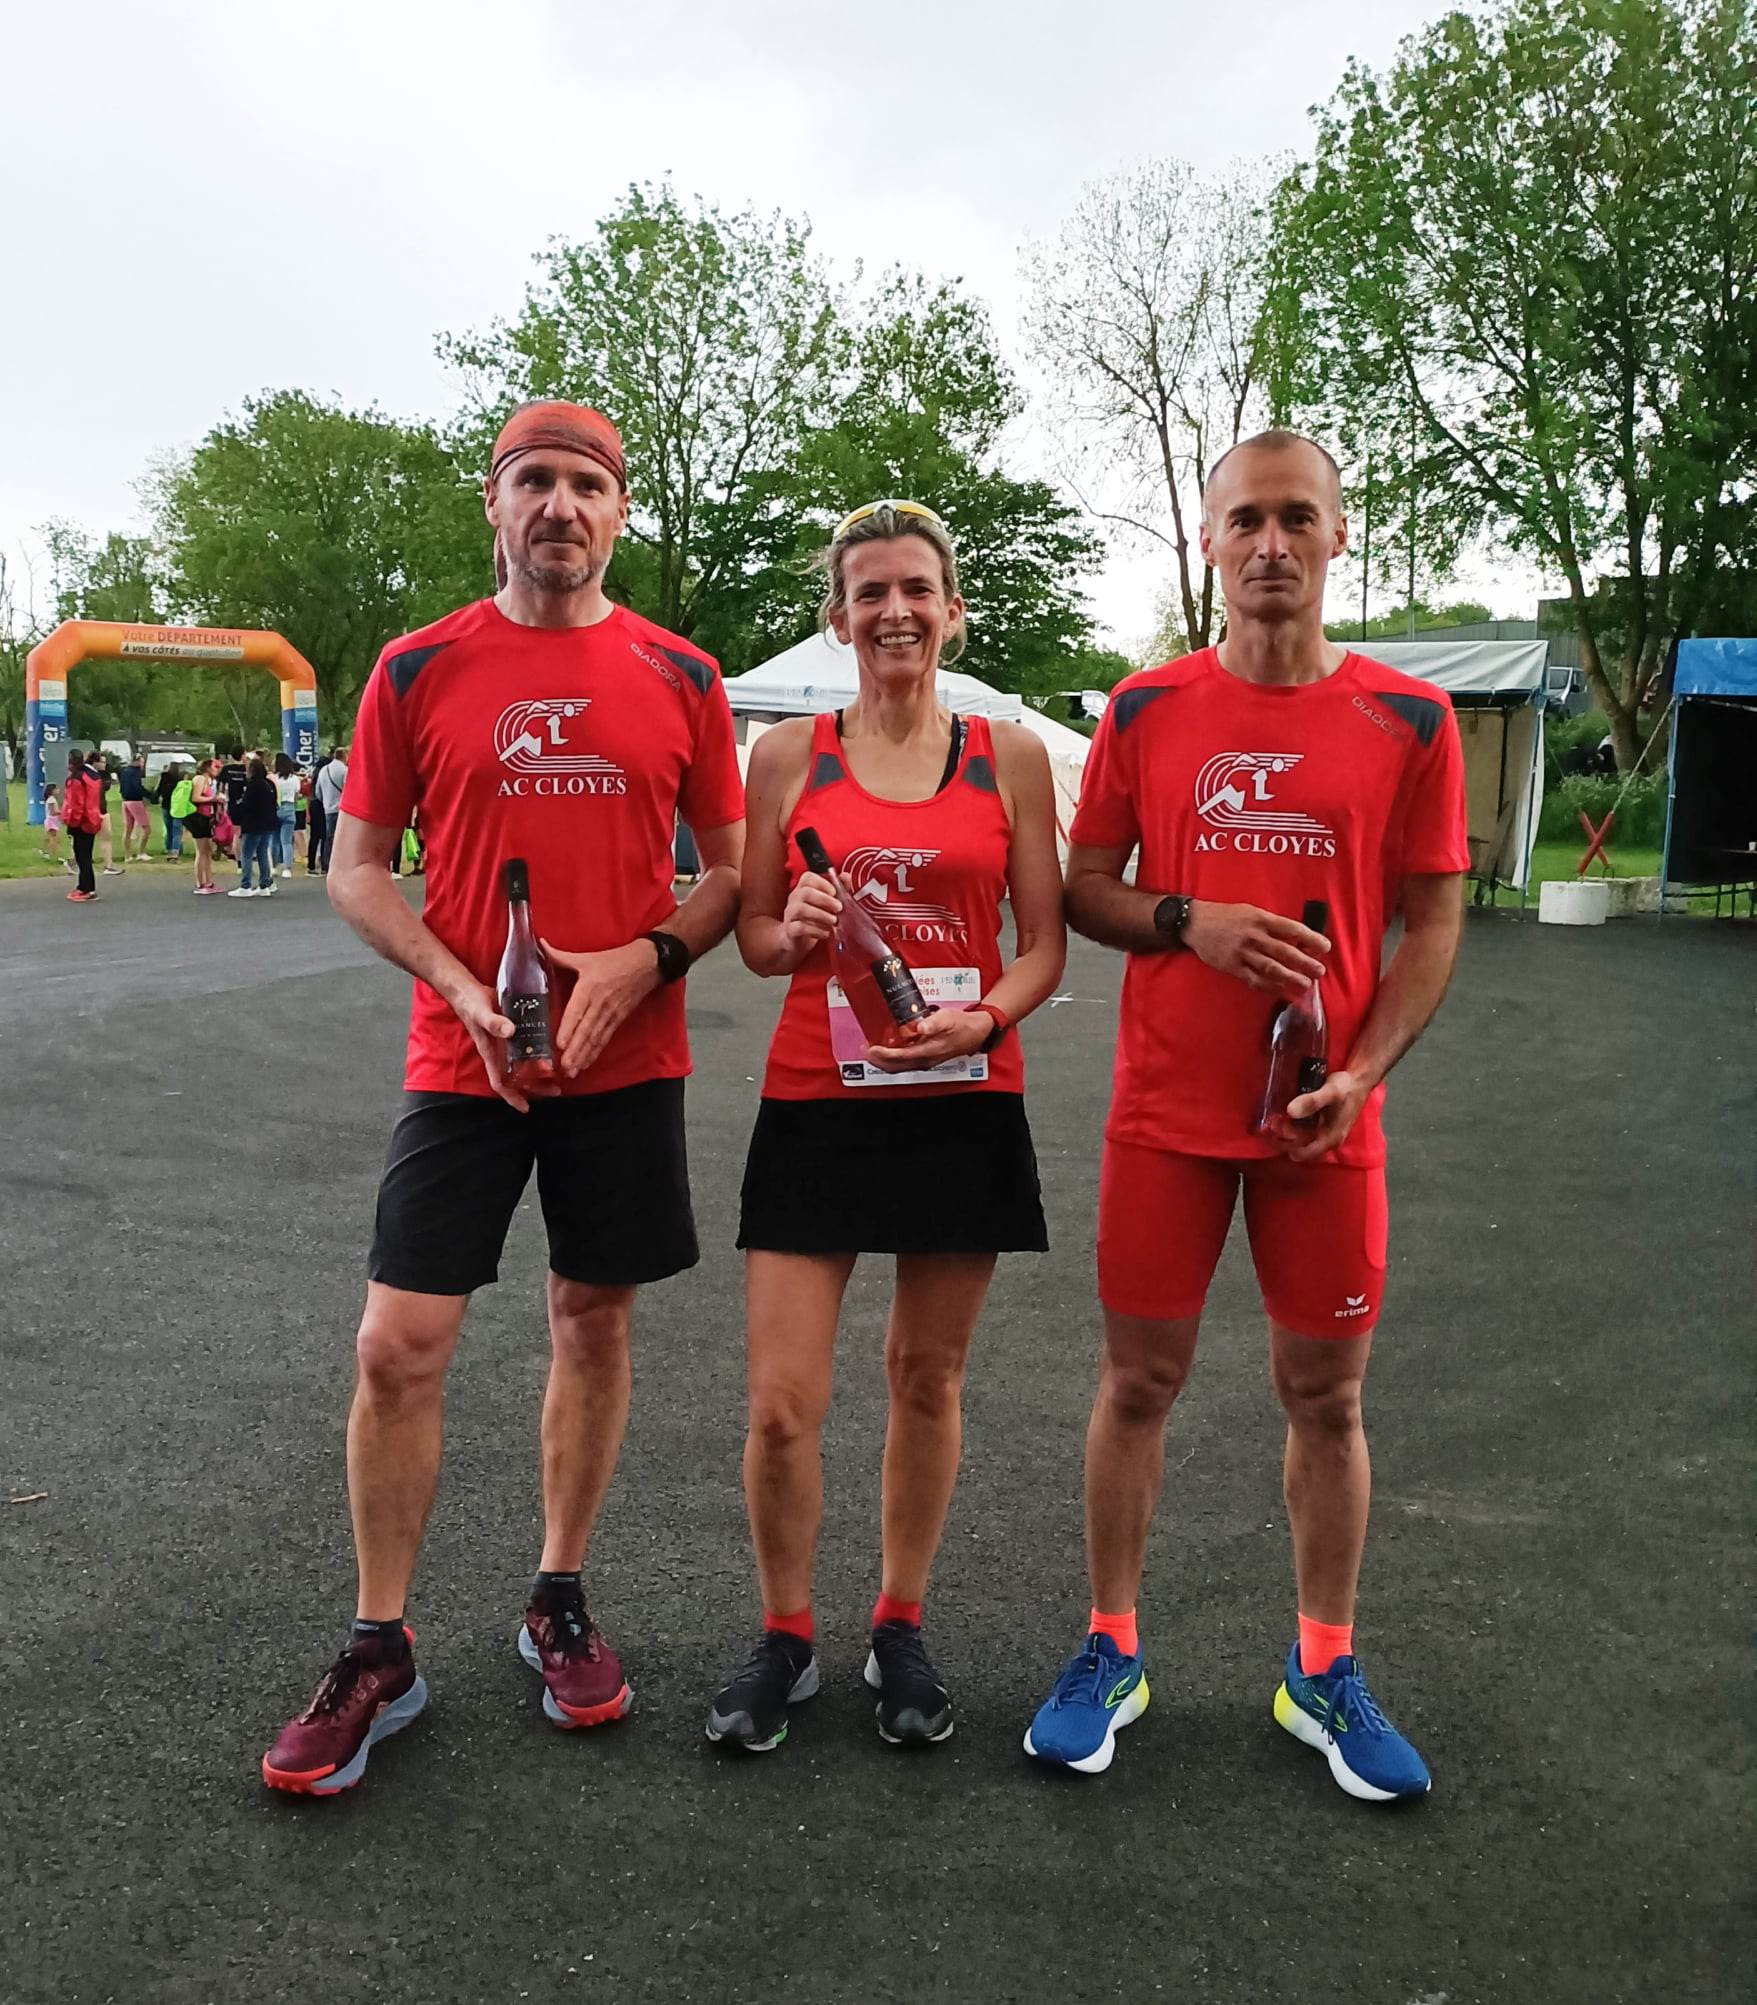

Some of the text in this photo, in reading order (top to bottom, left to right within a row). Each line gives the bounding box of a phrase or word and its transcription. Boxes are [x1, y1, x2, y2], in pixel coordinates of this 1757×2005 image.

[497, 776, 627, 797] AC CLOYES
[1194, 832, 1336, 858] AC CLOYES
